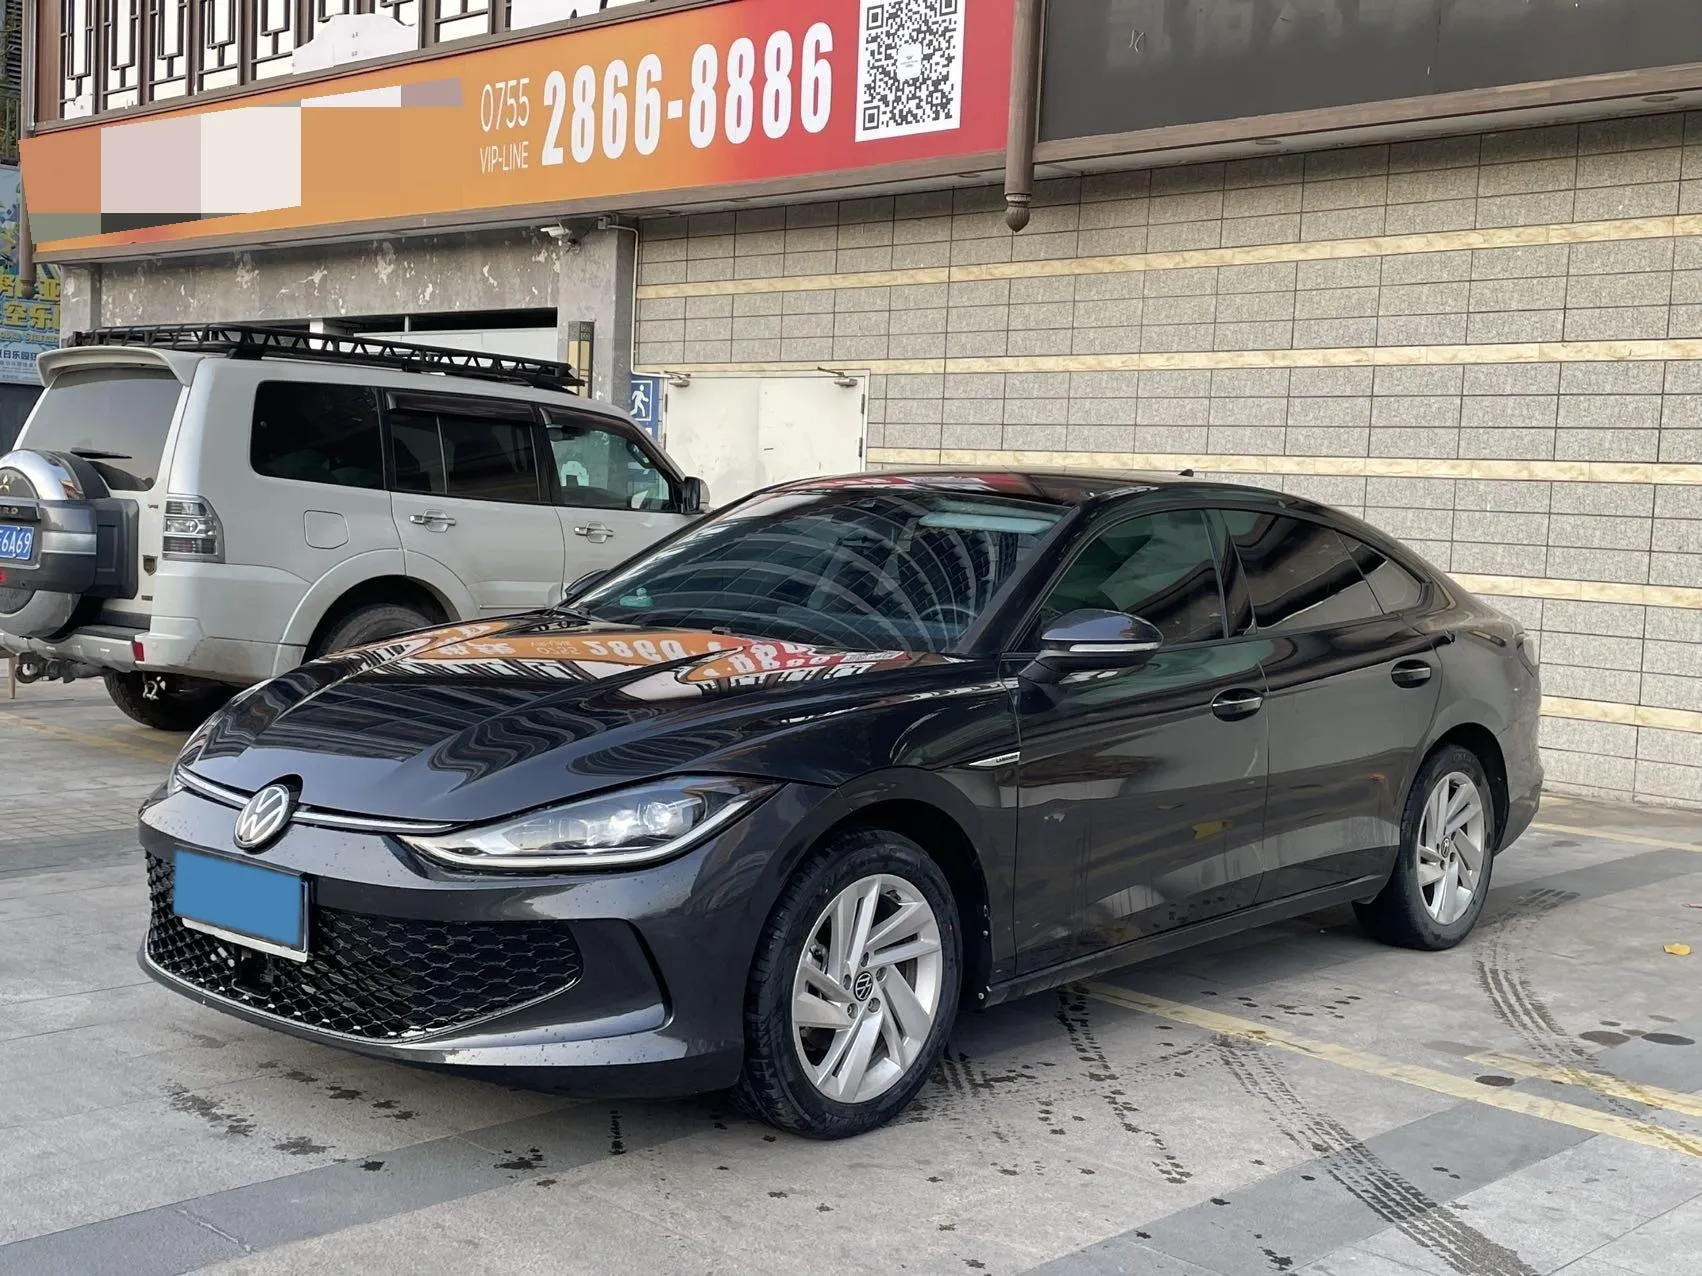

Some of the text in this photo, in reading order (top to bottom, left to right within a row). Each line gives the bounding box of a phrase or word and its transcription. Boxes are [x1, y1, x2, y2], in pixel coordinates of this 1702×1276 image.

[480, 78, 530, 132] 0755
[541, 22, 834, 166] 2866-8886
[480, 141, 529, 174] VIP-LINE
